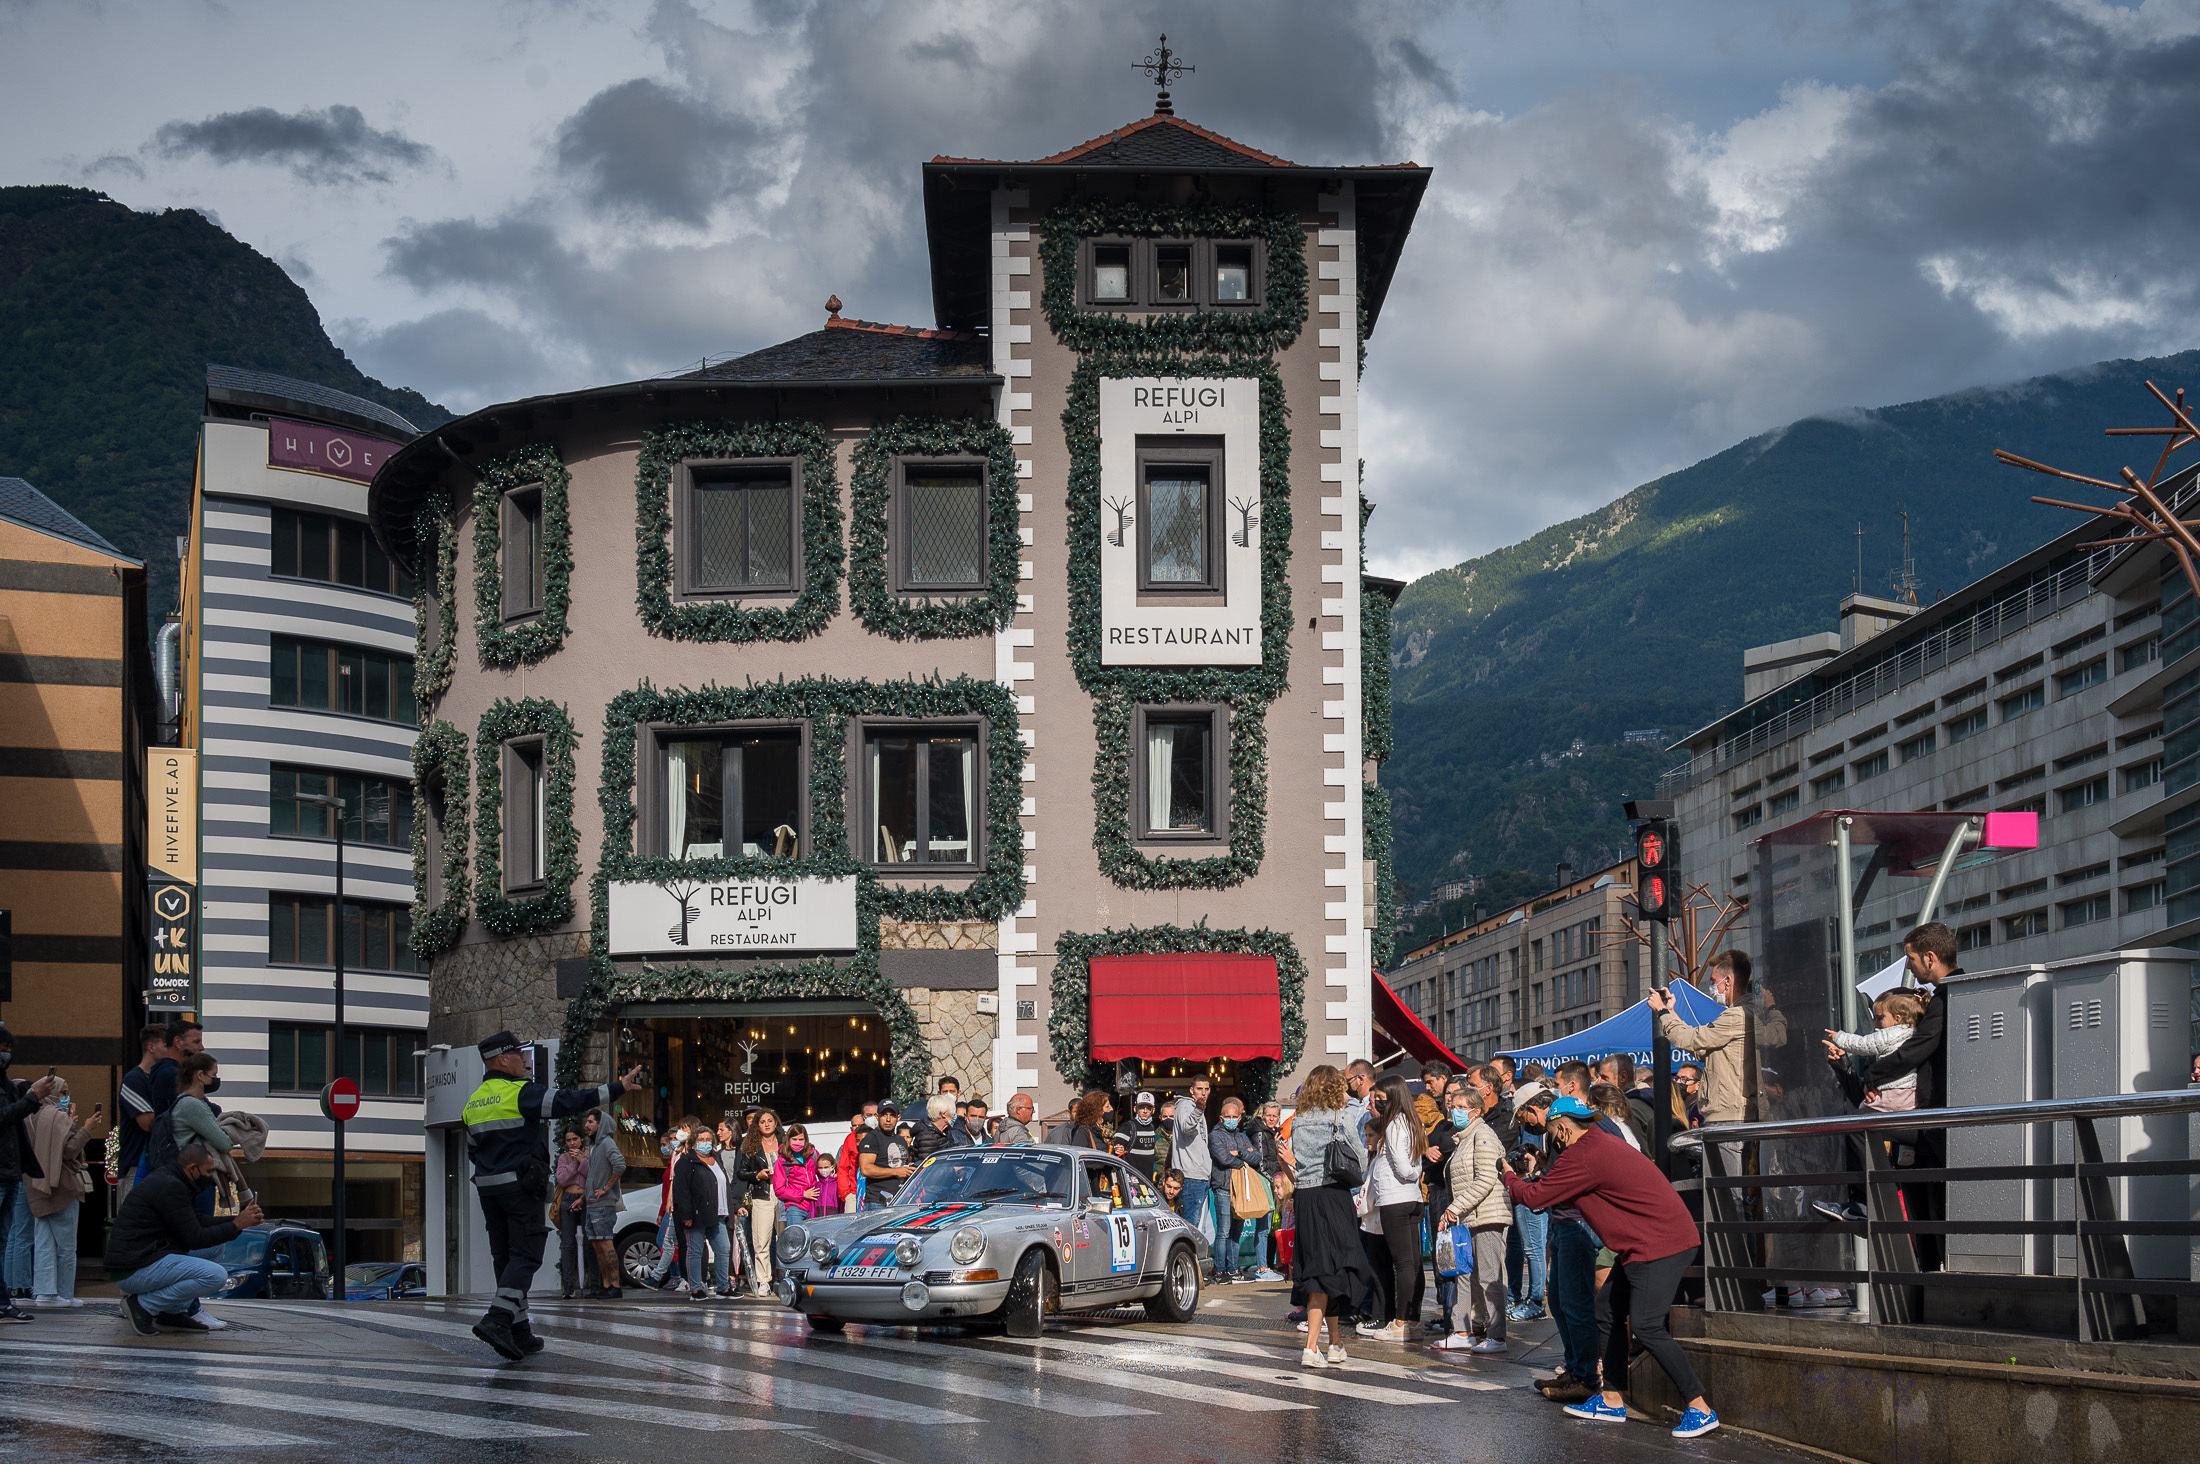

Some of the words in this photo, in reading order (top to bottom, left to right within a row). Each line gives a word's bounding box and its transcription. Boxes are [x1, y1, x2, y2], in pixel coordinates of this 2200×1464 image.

[1134, 387, 1225, 408] REFUGI
[1109, 627, 1254, 645] RESTAURANT
[166, 757, 179, 863] HIVEFIVE.AD
[710, 885, 797, 906] REFUGI
[710, 933, 797, 945] RESTAURANT
[154, 953, 190, 975] UN
[153, 977, 190, 987] COWORK
[1019, 1005, 1034, 1018] 73
[435, 1071, 456, 1087] MAISON
[724, 1082, 775, 1094] REFUGI
[467, 1094, 501, 1110] CIRCULACIÓ
[1114, 1216, 1130, 1248] 15
[1077, 1275, 1140, 1291] PORSCHE
